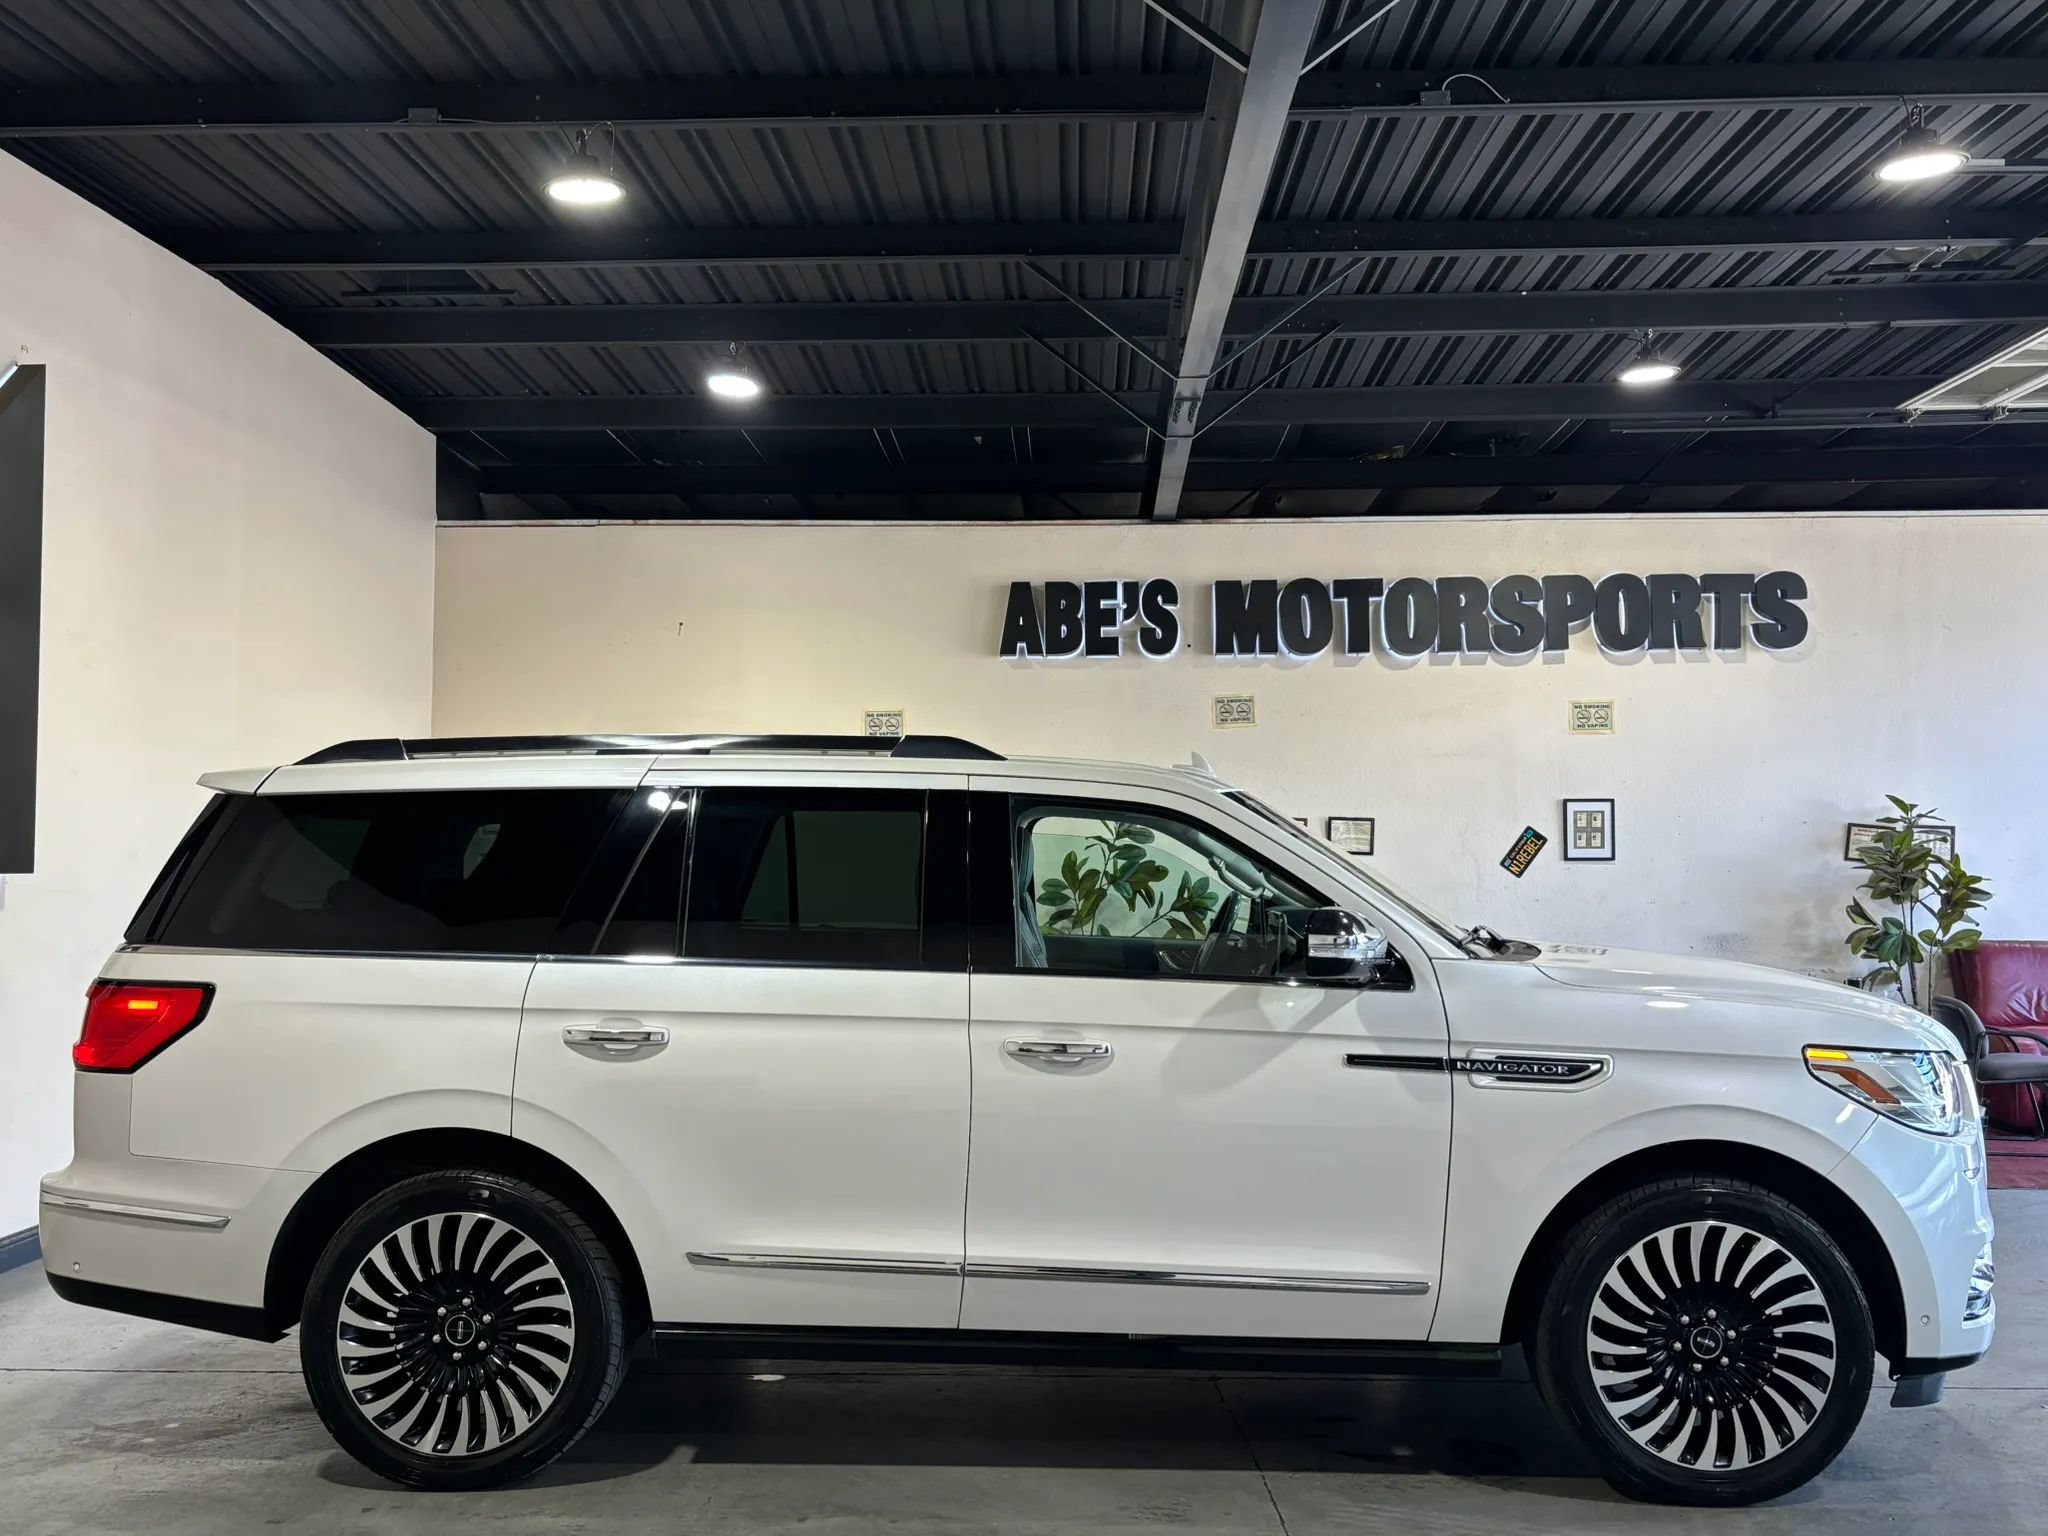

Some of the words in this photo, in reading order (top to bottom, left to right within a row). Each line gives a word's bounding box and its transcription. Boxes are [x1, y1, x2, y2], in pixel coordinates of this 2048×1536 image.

[999, 578, 1179, 658] ABE'S
[1213, 571, 1808, 657] MOTORSPORTS
[1456, 1061, 1569, 1074] NAVIGATOR
